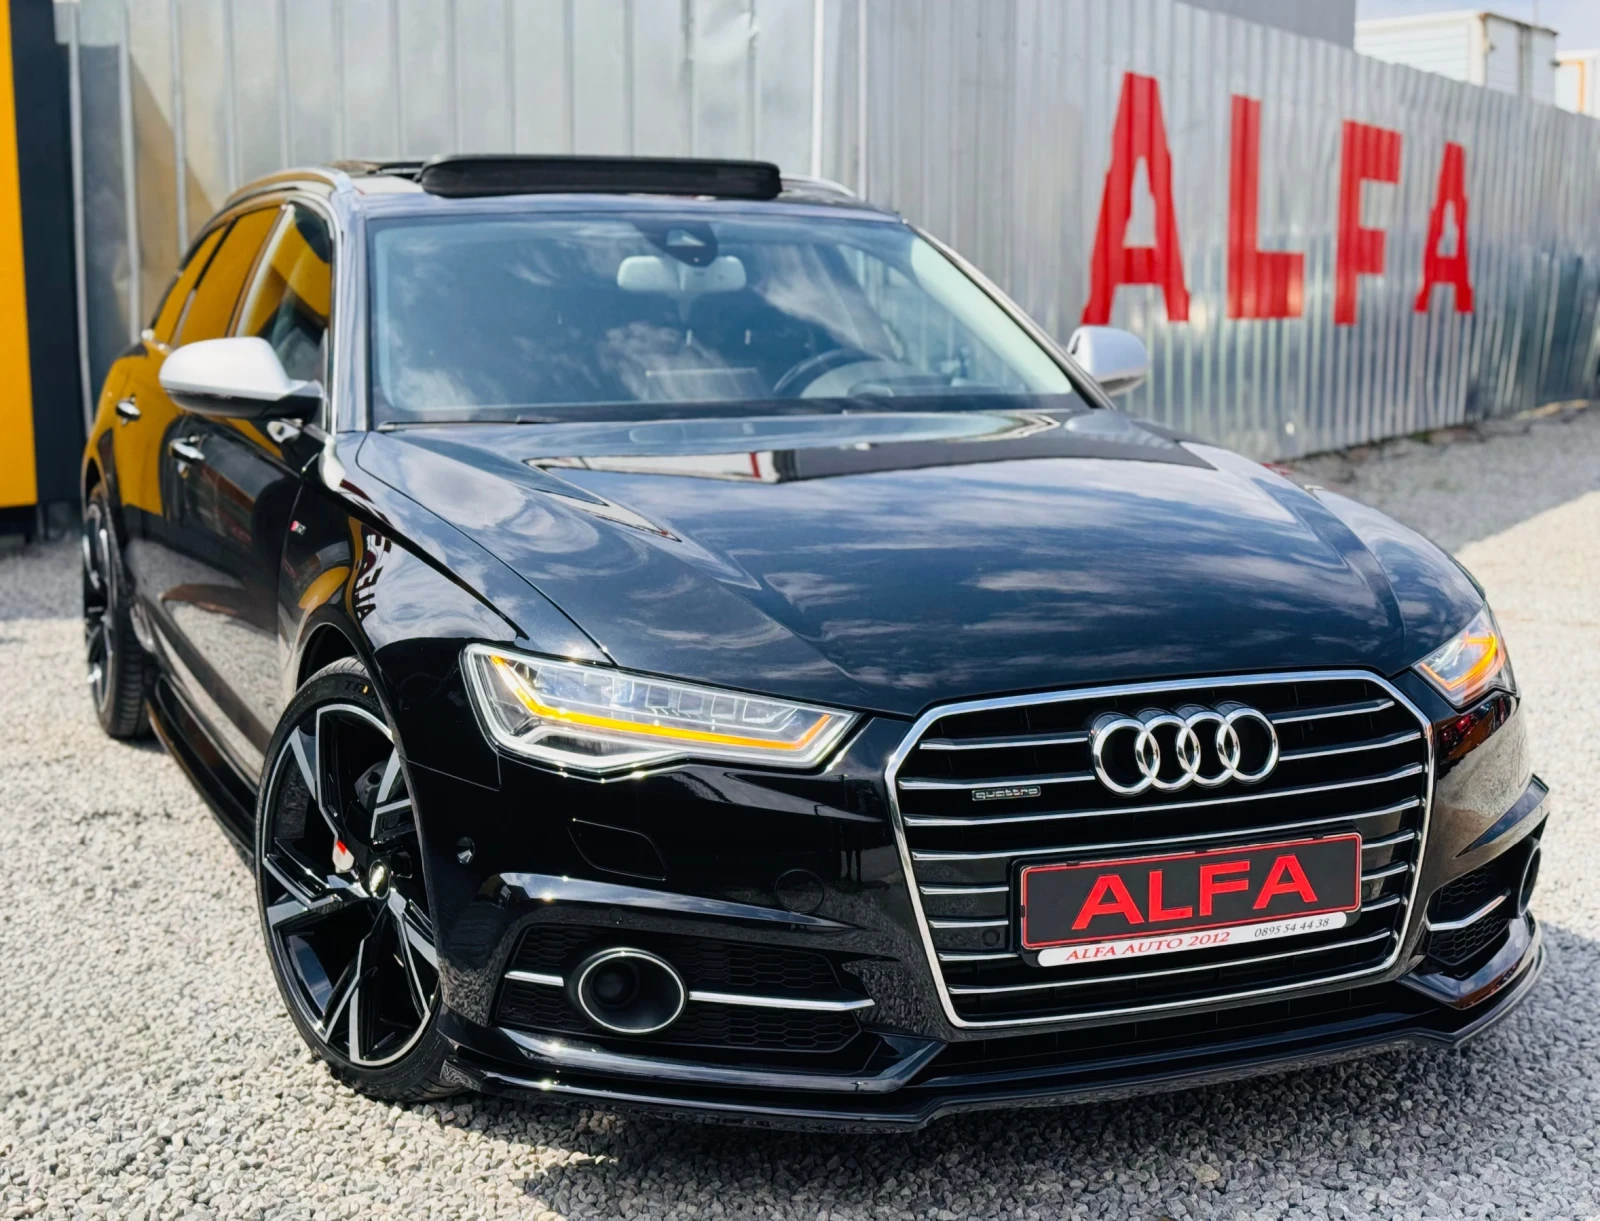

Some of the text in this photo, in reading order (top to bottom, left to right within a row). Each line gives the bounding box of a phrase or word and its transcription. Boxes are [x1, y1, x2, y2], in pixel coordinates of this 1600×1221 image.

[1080, 71, 1475, 326] ALFA
[975, 788, 1038, 800] quattro
[1071, 853, 1318, 931] ALFA
[1254, 917, 1330, 938] 0895 54 44 38
[1064, 931, 1231, 962] ALFA AUTO 2012
